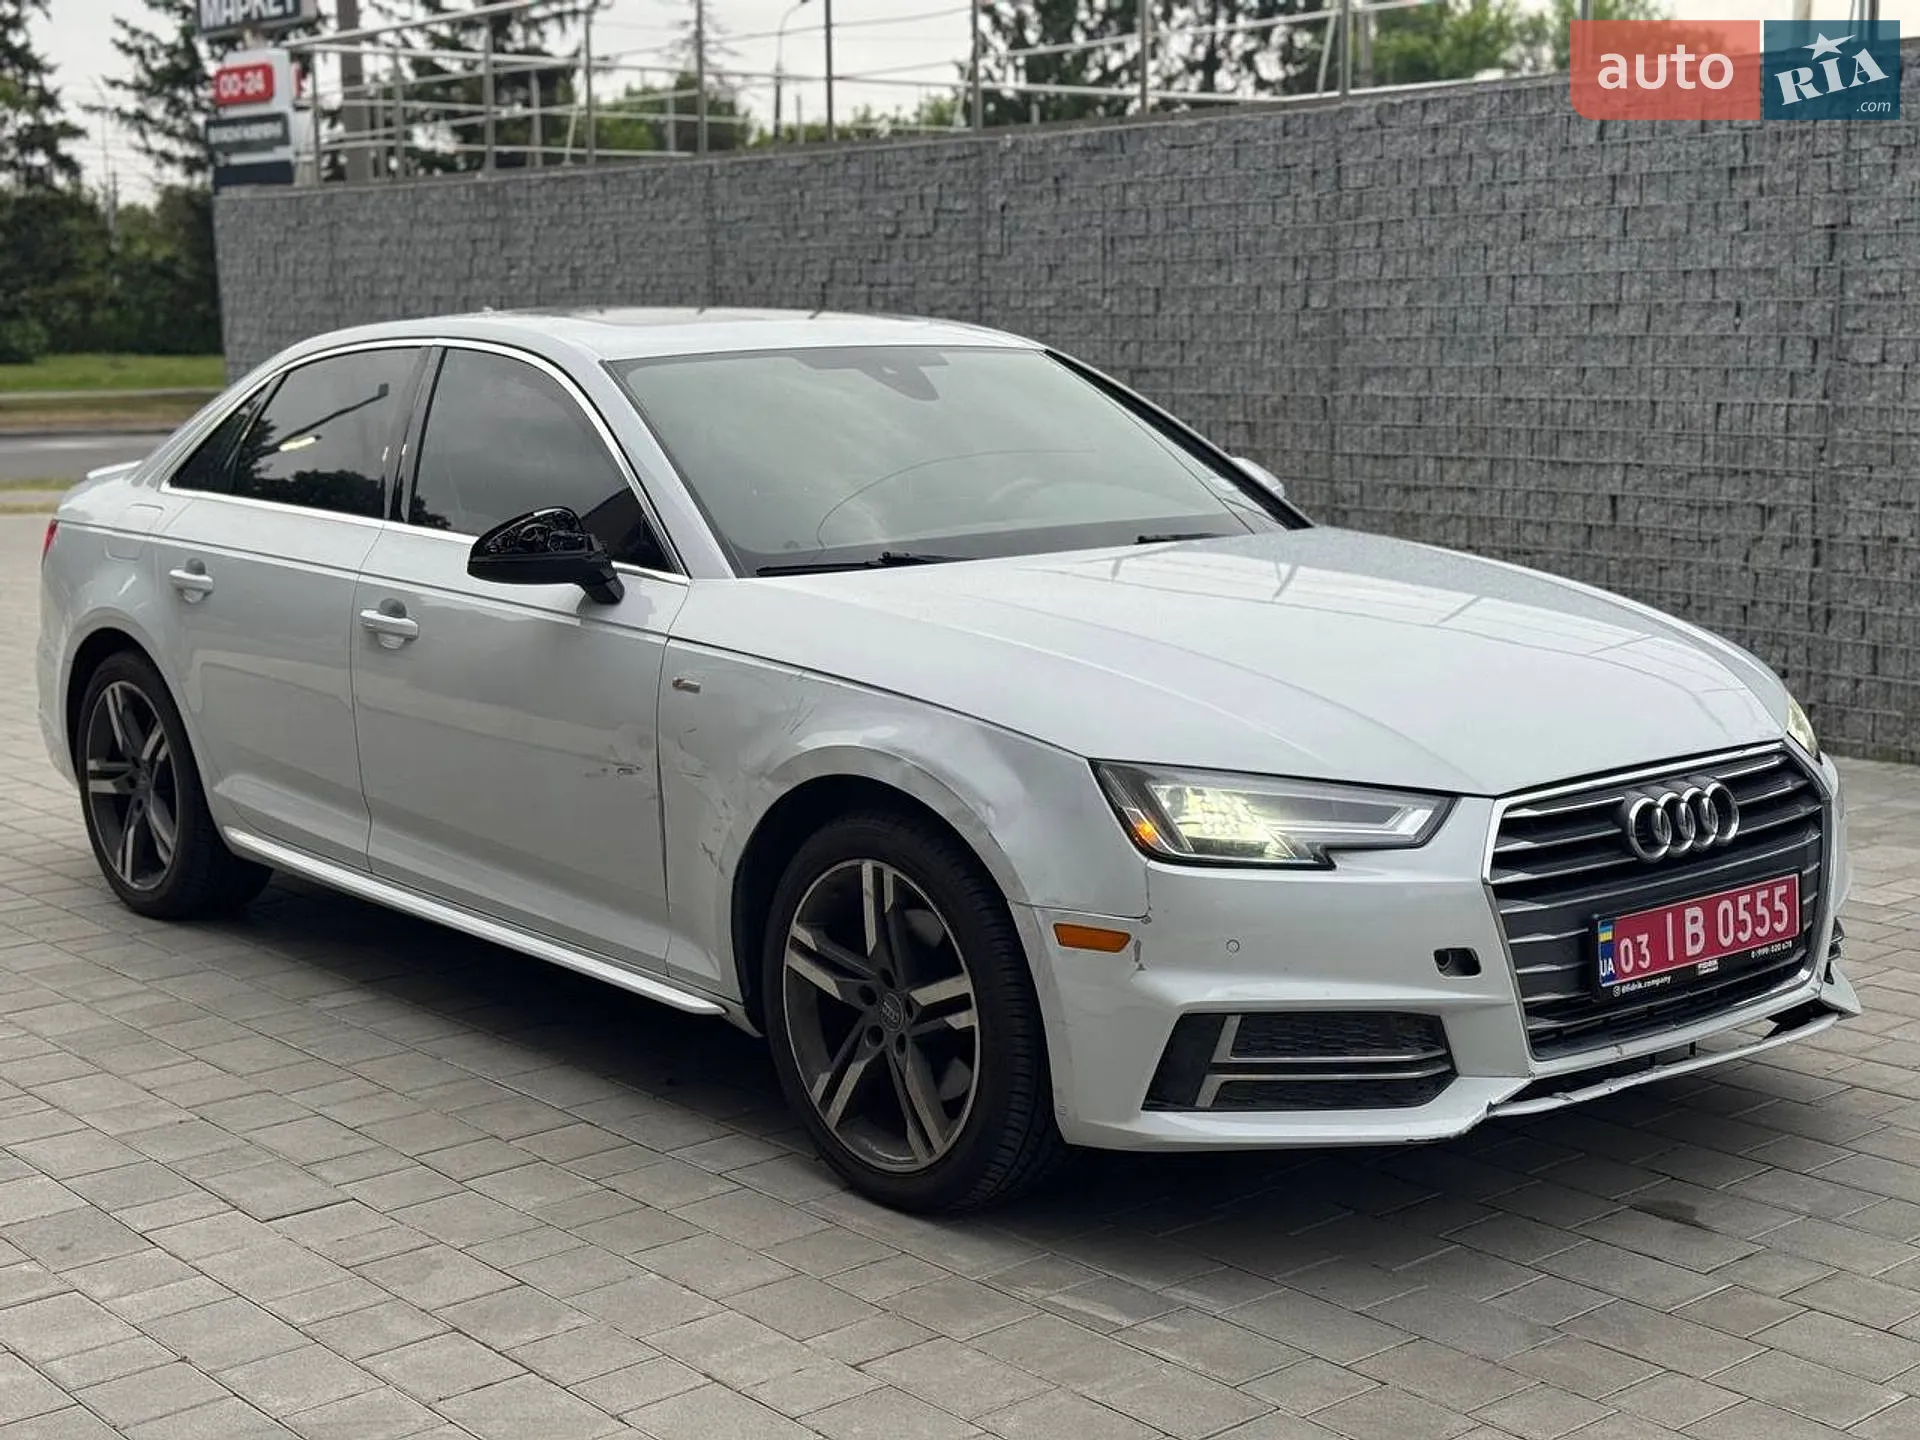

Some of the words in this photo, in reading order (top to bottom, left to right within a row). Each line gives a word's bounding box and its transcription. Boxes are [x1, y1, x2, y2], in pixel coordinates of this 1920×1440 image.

[1619, 932, 1651, 973] 03
[1717, 886, 1788, 947] 0555
[1599, 958, 1615, 976] UA
